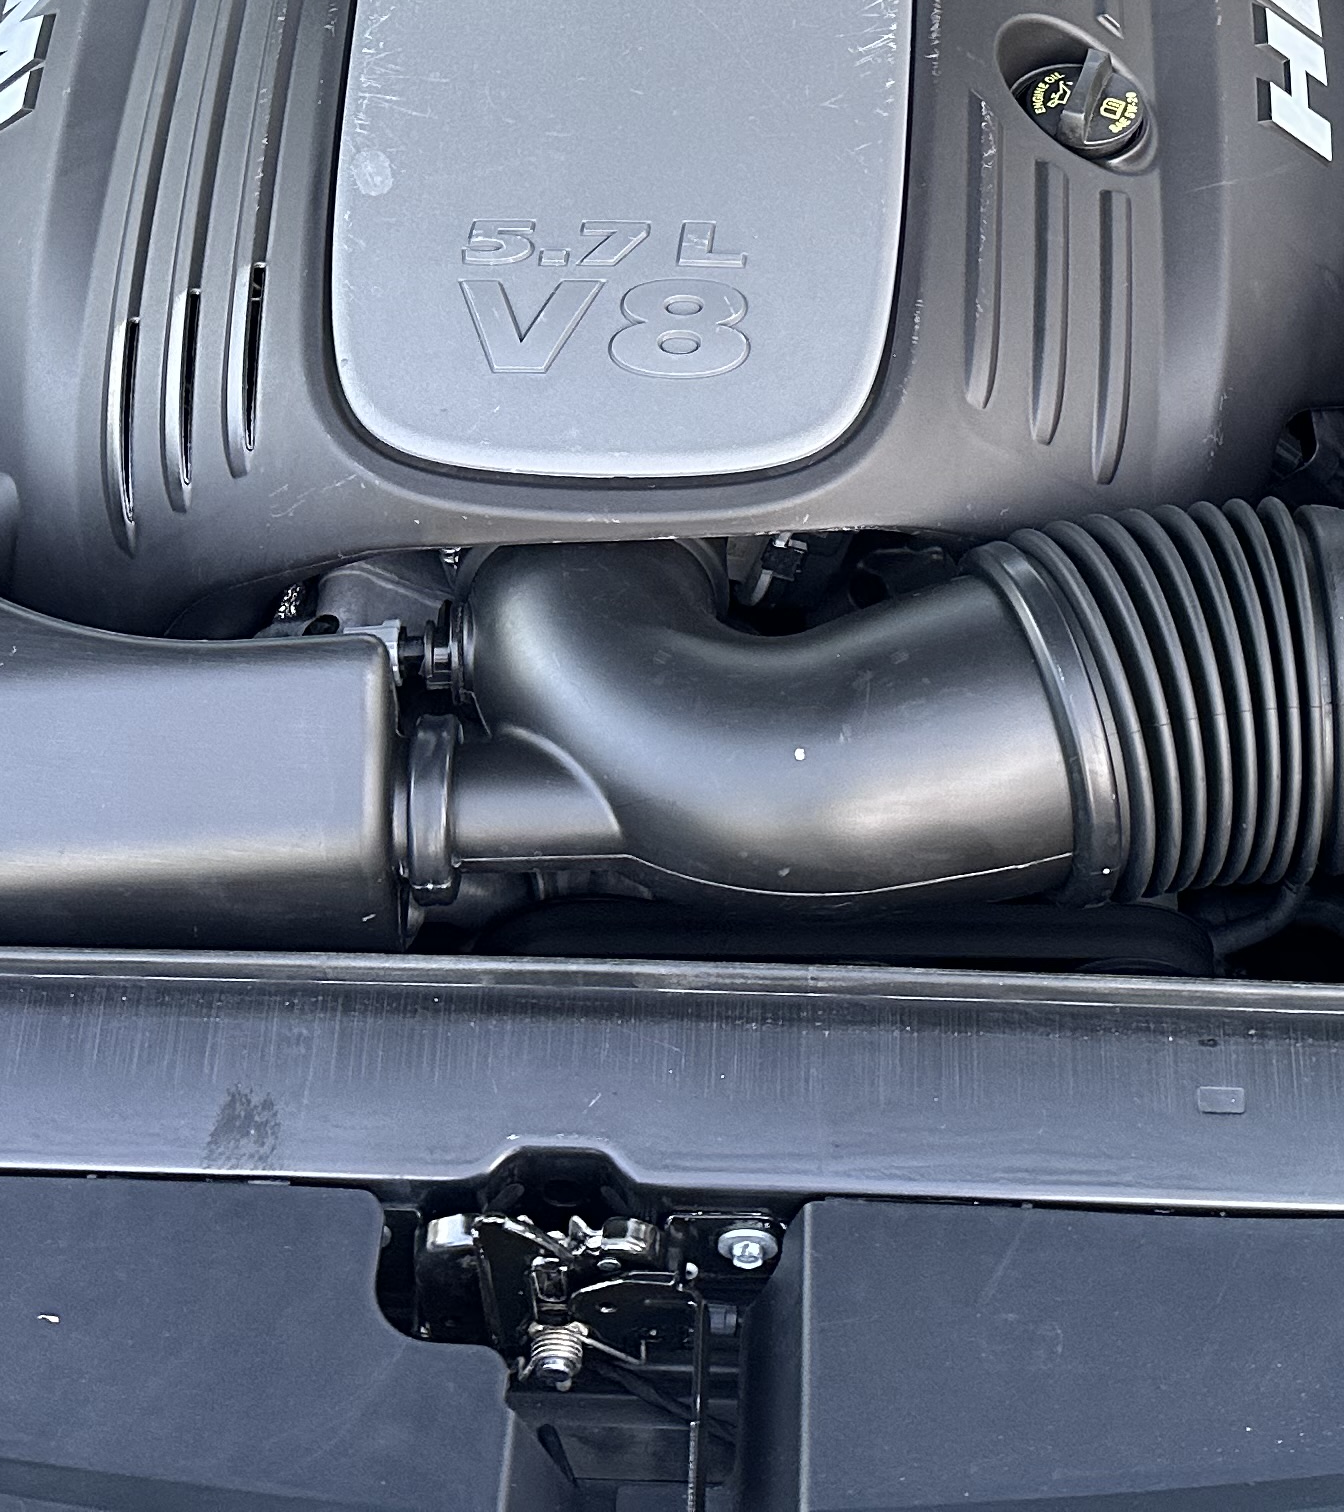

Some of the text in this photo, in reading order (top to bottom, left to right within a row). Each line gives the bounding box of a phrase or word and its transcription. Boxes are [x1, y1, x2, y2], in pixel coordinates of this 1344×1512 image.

[1032, 71, 1065, 115] ENGINE OIL
[461, 218, 748, 269] 5.7 L
[457, 278, 752, 380] V8
